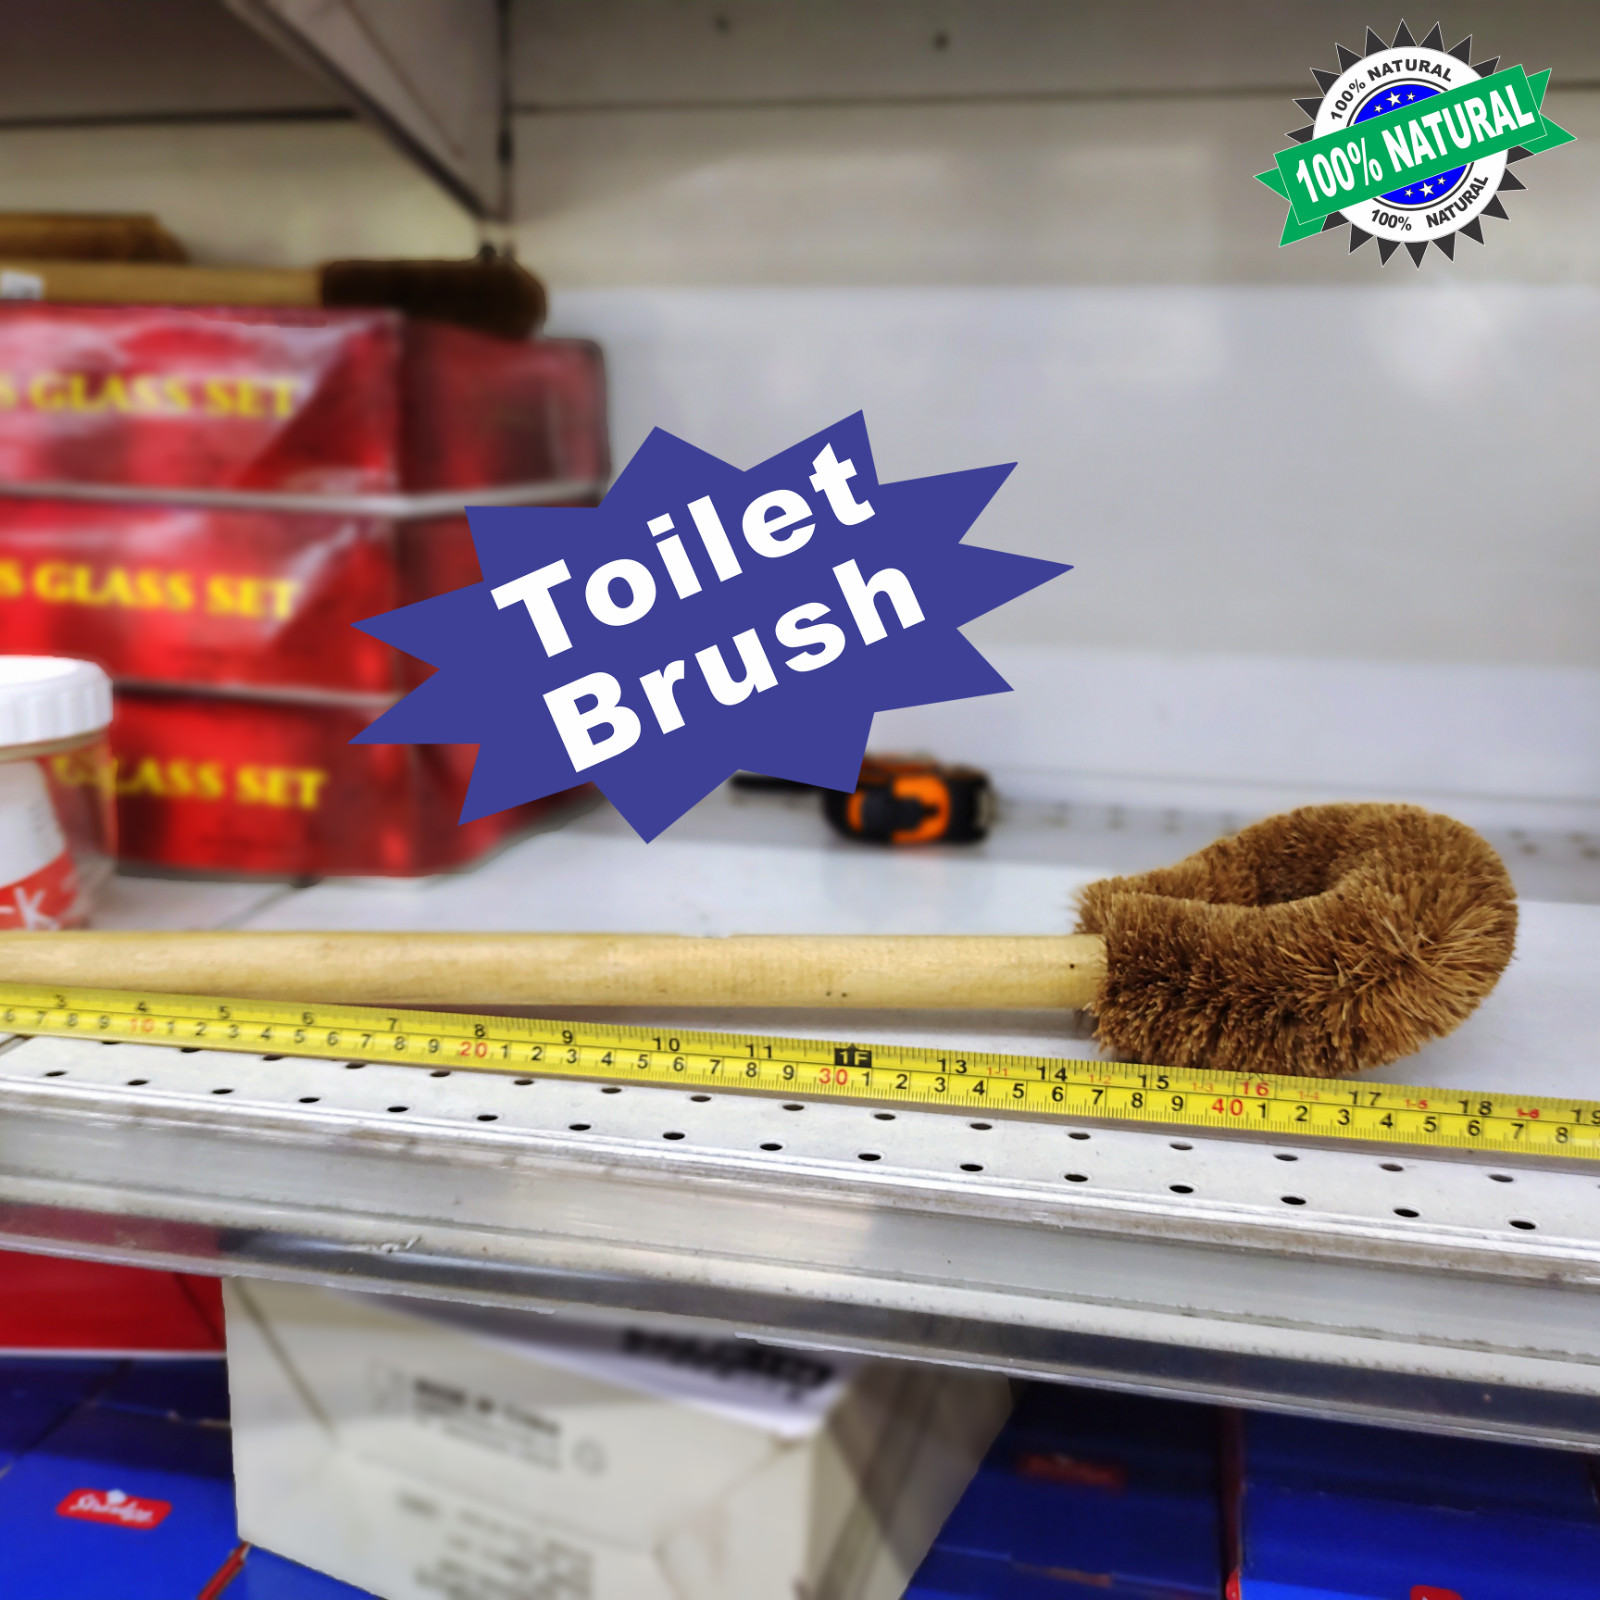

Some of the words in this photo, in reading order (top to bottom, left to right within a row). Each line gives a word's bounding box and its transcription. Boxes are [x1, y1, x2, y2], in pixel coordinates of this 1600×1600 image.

[30, 371, 192, 415] GLASS
[204, 377, 299, 420] SET
[33, 560, 194, 614] GLASS
[205, 574, 300, 623] SET
[237, 763, 324, 810] SET
[194, 1021, 208, 1037] 2
[227, 1023, 240, 1039] 3
[259, 1026, 273, 1040] 4
[294, 1028, 306, 1044] 5
[326, 1031, 340, 1046] 6
[360, 1033, 373, 1048] 7
[393, 1035, 407, 1051] 8
[428, 1038, 441, 1054] 9
[459, 1040, 488, 1058] 20
[501, 1043, 509, 1059] 1
[530, 1045, 544, 1062] 2
[566, 1047, 578, 1065] 3
[600, 1050, 614, 1066] 4
[637, 1053, 650, 1069] 5
[673, 1056, 686, 1072] 6
[709, 1059, 721, 1075] 7
[745, 1061, 758, 1078] 8
[782, 1064, 795, 1081] 9
[819, 1067, 849, 1086] 30
[861, 1071, 871, 1087] 1
[895, 1073, 909, 1090] 2
[934, 1076, 947, 1093] 3
[972, 1079, 986, 1096] 4
[1011, 1082, 1025, 1099] 5
[1051, 1086, 1065, 1102] 6
[1091, 1088, 1105, 1105] 7
[1131, 1092, 1144, 1109] 8
[1171, 1095, 1185, 1112] 9
[1211, 1097, 1244, 1116] 40
[1256, 1102, 1267, 1119] 1
[1294, 1105, 1309, 1122] 2
[1337, 1108, 1351, 1126] 3
[1379, 1112, 1394, 1129] 4
[1423, 1115, 1438, 1133] 5
[1467, 1119, 1481, 1137] 6
[1510, 1122, 1525, 1140] 7
[1555, 1126, 1569, 1144] 8
[219, 1005, 231, 1020] 5
[302, 1011, 315, 1025] 6
[387, 1017, 398, 1031] 7
[473, 1023, 486, 1038] 8
[561, 1029, 574, 1044] 9
[653, 1036, 681, 1052] 10
[745, 1043, 772, 1059] 11
[840, 1051, 869, 1066] 1F
[937, 1058, 968, 1074] 13
[1036, 1065, 1068, 1082] 14
[1137, 1074, 1170, 1090] 15
[1239, 1080, 1270, 1097] 16
[1348, 1090, 1382, 1107] 17
[1458, 1099, 1493, 1116] 18
